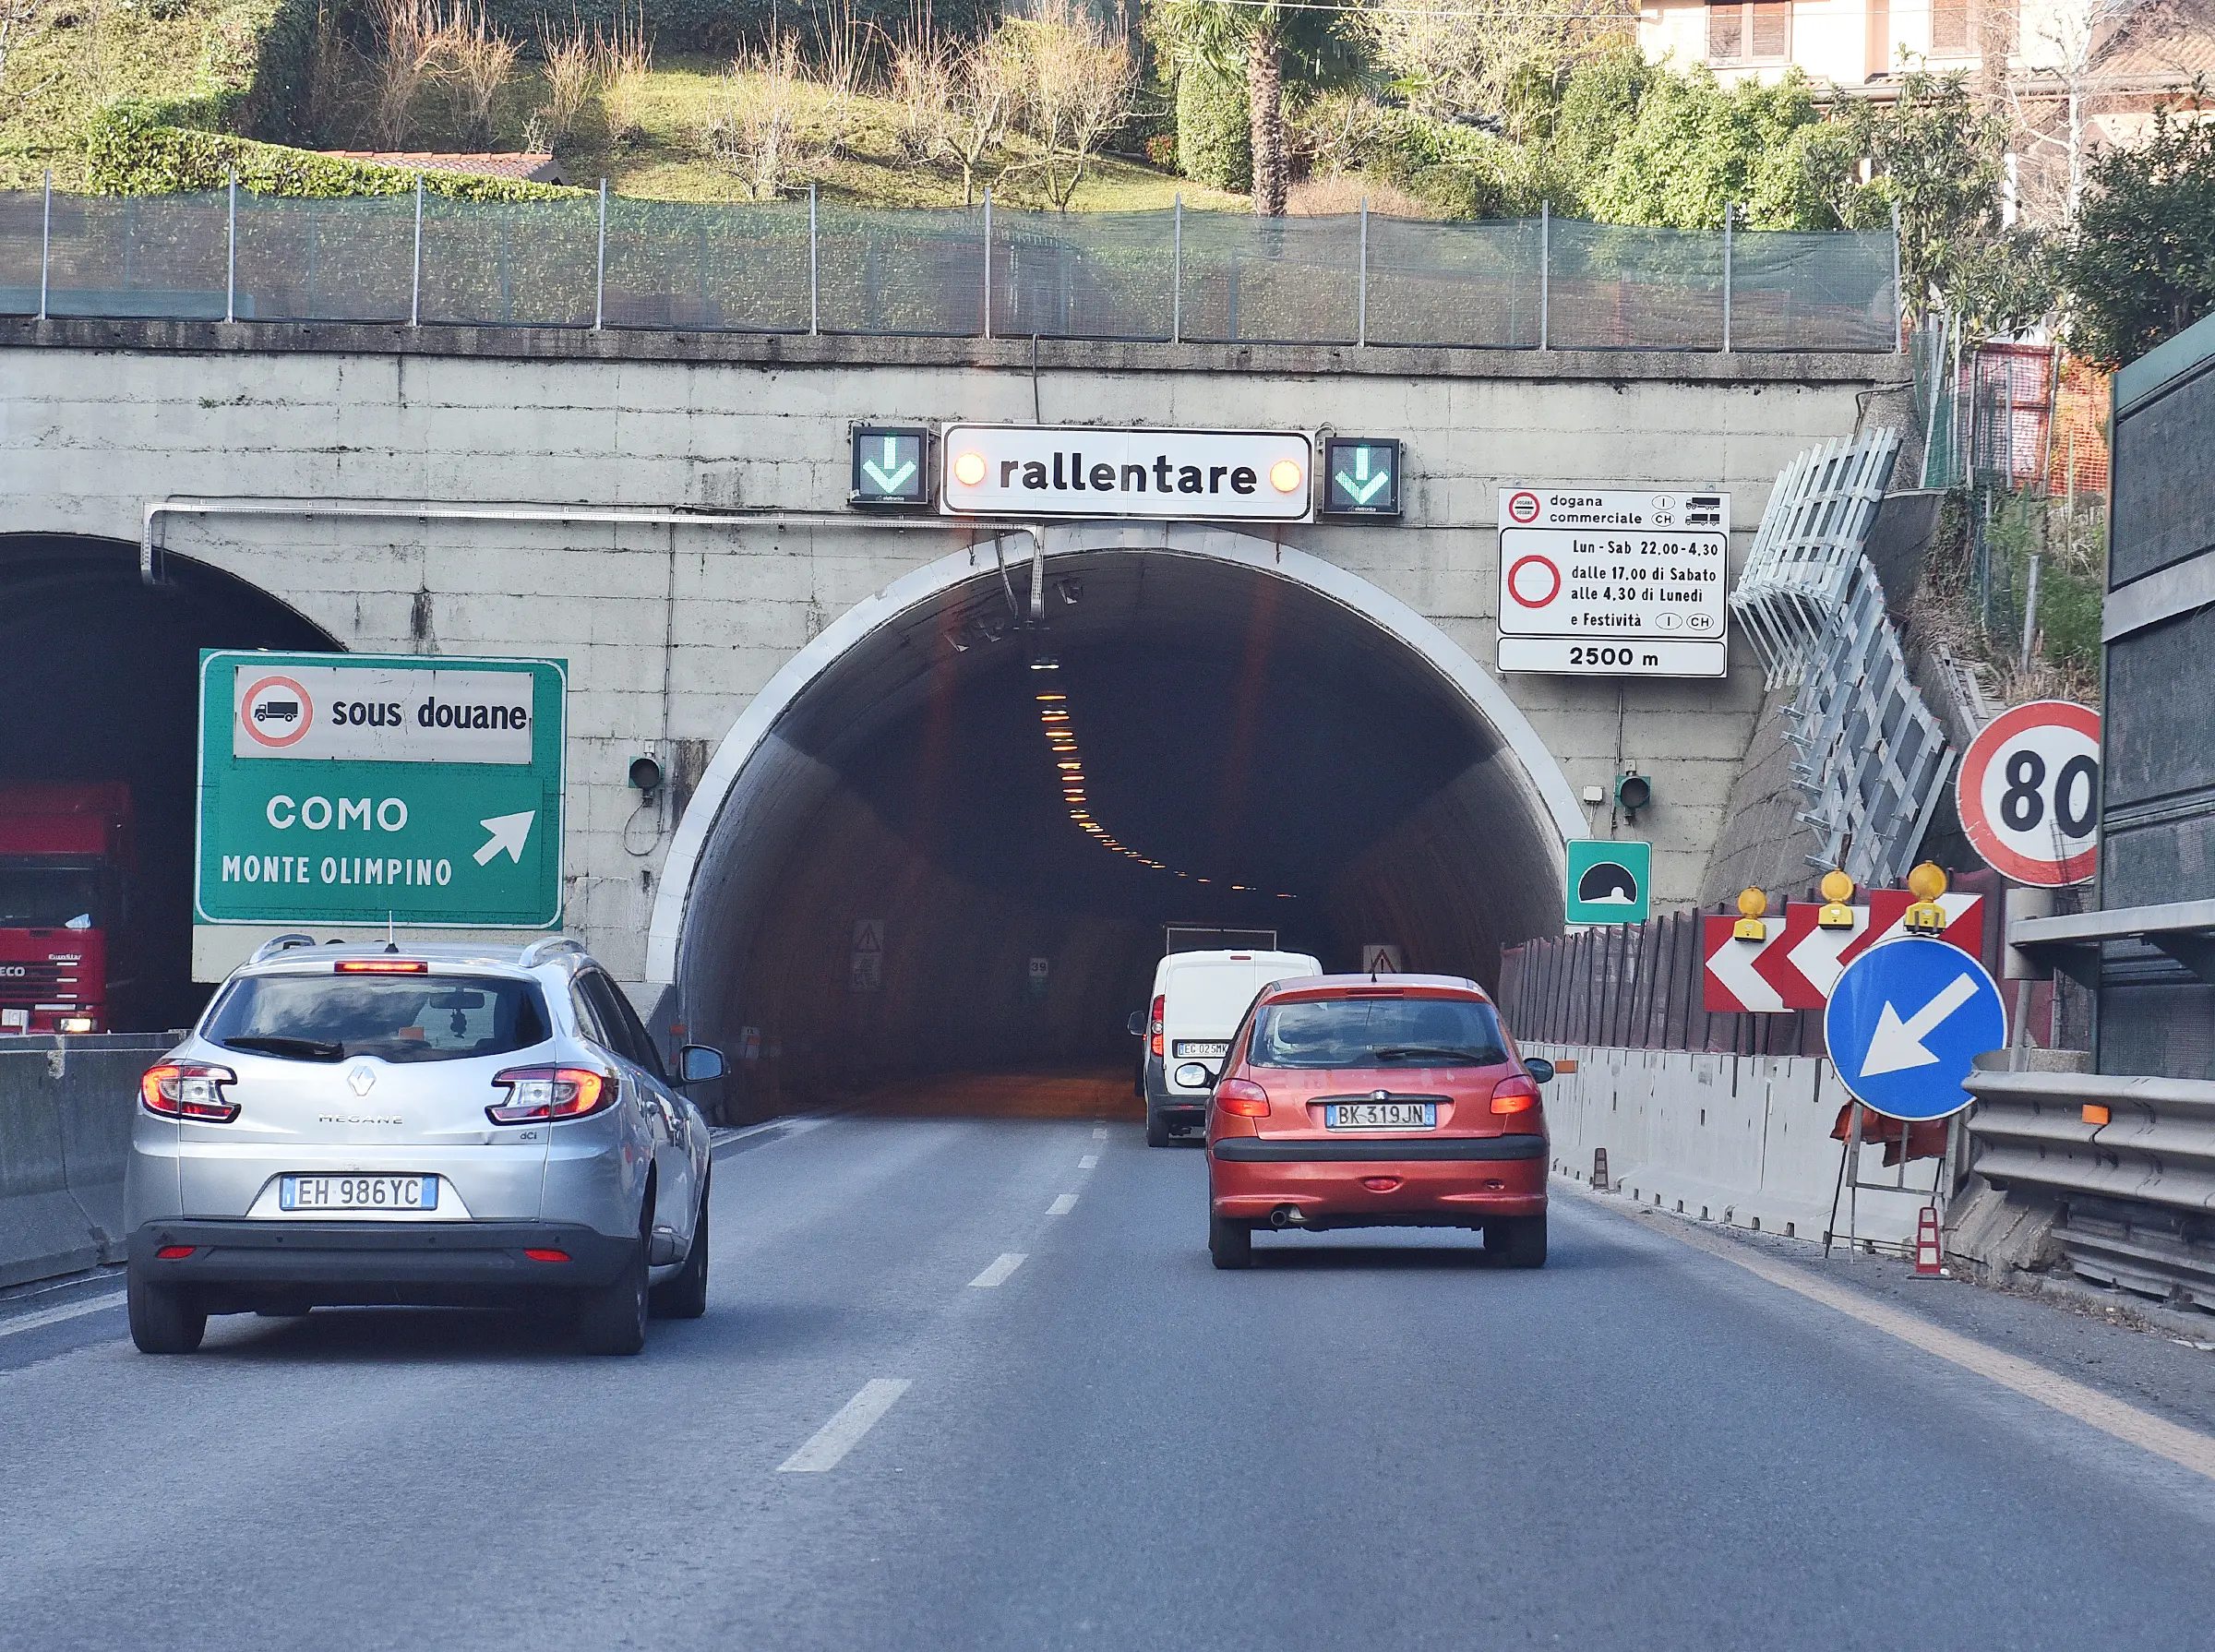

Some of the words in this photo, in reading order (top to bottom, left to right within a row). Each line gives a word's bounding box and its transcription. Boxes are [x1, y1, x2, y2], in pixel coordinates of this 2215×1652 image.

[1000, 451, 1257, 495] rallentare
[1550, 494, 1603, 509] dogana
[1550, 511, 1643, 524] commerciale
[1655, 514, 1671, 524] CH
[1573, 539, 1595, 554] Lun
[1608, 540, 1632, 555] Sab
[1571, 565, 1607, 580] dalle
[1652, 567, 1664, 581] di
[1670, 568, 1717, 581] Sabato
[1571, 586, 1598, 600] alle
[1641, 588, 1654, 601] di
[1659, 588, 1704, 603] Lunedì
[1571, 616, 1578, 626] e
[1583, 612, 1642, 627] Festività
[1691, 617, 1710, 627] CH
[1569, 646, 1634, 666] 2500
[1642, 654, 1658, 666] m
[331, 700, 402, 727] sous
[417, 696, 527, 730] douane
[2000, 749, 2098, 838] 80
[266, 795, 408, 832] COMO
[222, 855, 310, 883] MONTE
[320, 856, 452, 886] OLIMPINO
[1031, 962, 1047, 972] 39
[317, 1112, 403, 1125] MEGANE
[1338, 1106, 1360, 1124] BK
[1367, 1105, 1423, 1124] 319JN
[520, 1131, 537, 1140] dCi
[298, 1179, 329, 1204] EH
[340, 1179, 419, 1205] 986YC
